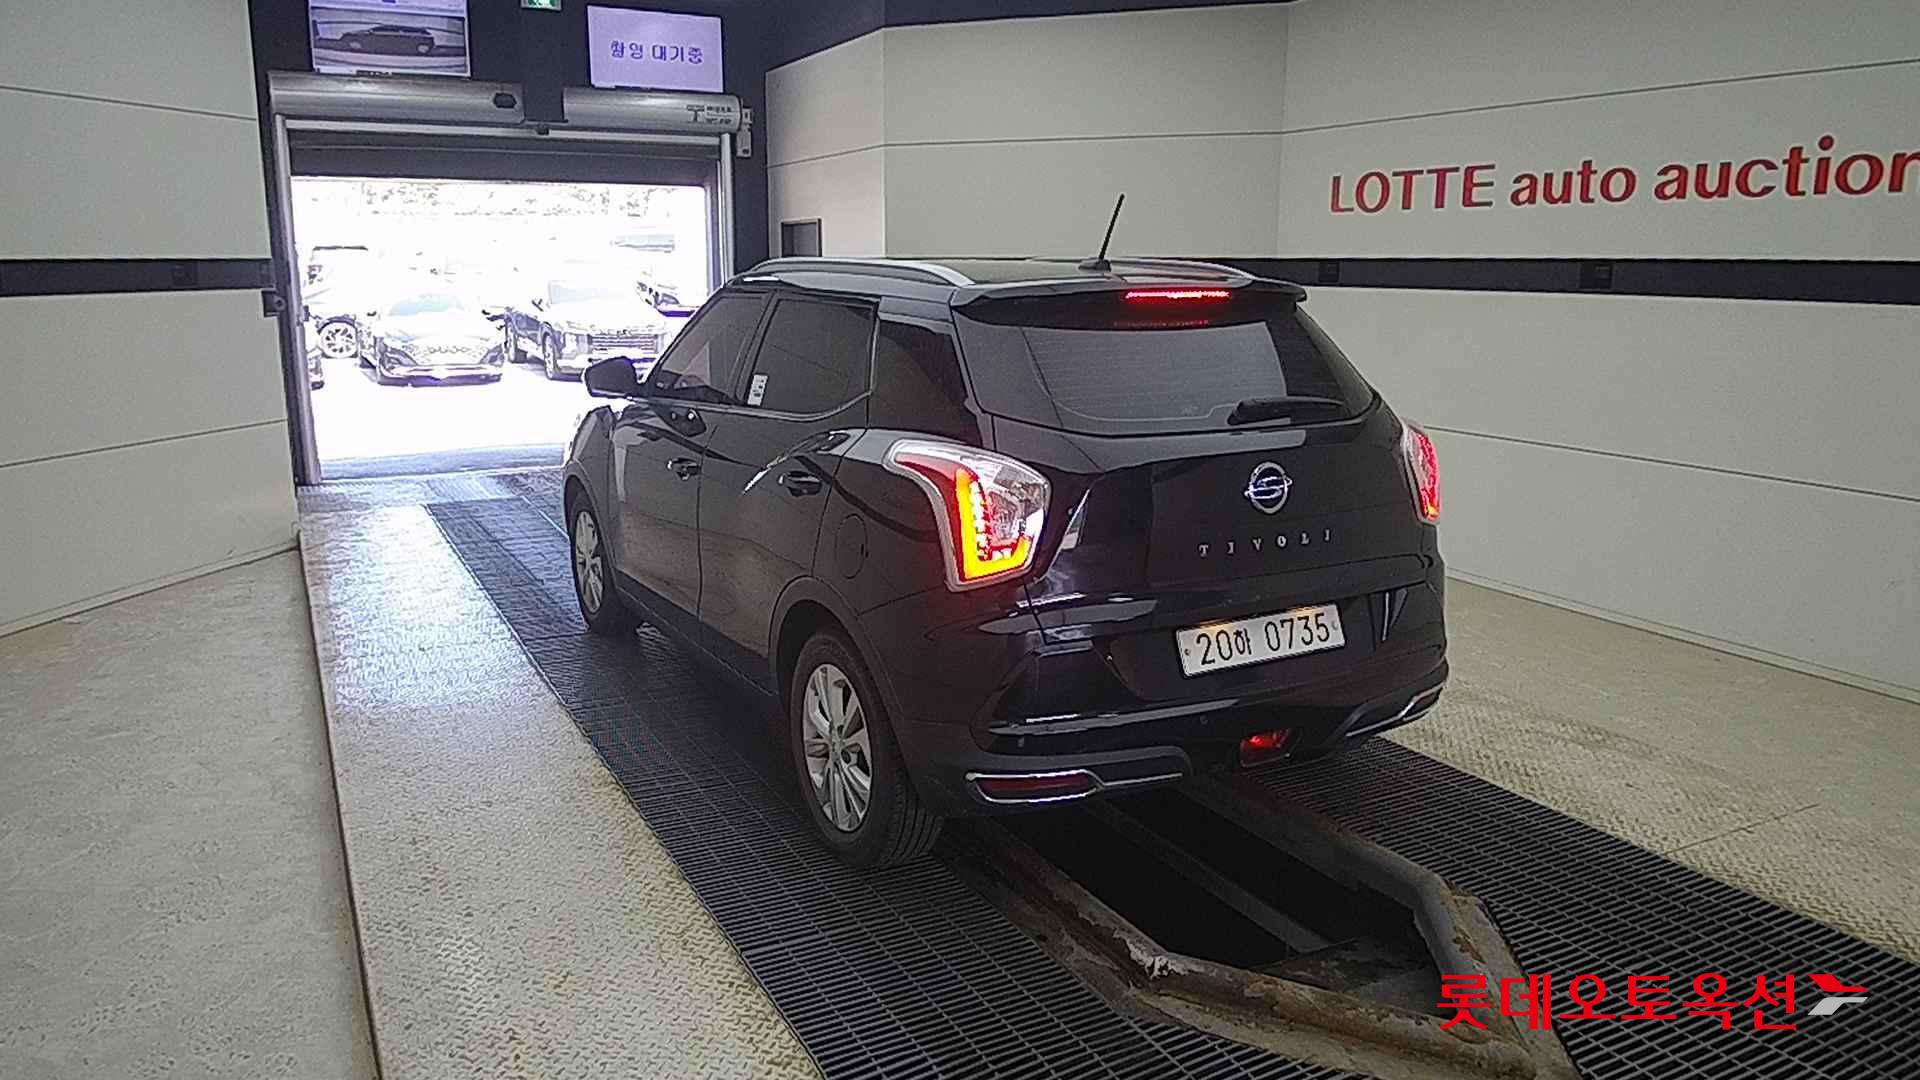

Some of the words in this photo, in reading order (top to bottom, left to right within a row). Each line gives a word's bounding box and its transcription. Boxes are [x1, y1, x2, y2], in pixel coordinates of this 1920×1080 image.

[651, 44, 703, 65] 대기중
[1330, 164, 1497, 213] LOTTE
[1510, 159, 1637, 207] auto
[1199, 528, 1331, 557] TIVOLI
[1195, 627, 1253, 666] 20하
[1264, 612, 1331, 652] 0735
